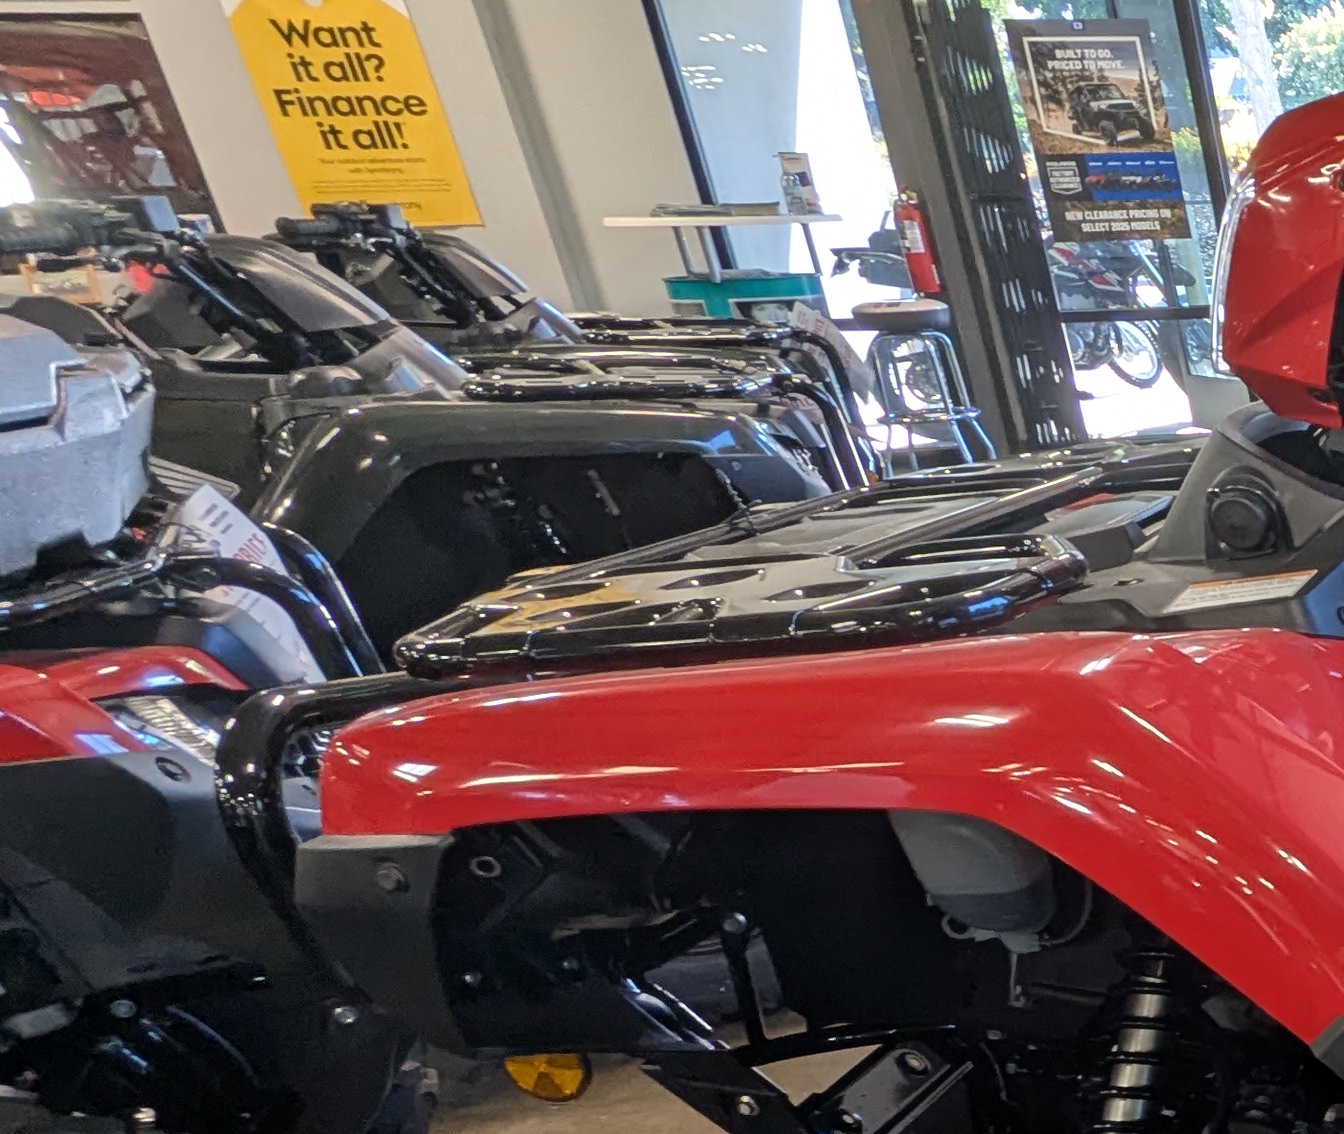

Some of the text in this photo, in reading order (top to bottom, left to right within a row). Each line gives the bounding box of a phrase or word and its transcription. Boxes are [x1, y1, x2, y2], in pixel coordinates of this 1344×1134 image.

[267, 18, 382, 48] Want
[286, 52, 385, 82] it all?
[1046, 60, 1082, 70] PRICED
[1082, 60, 1096, 70] TO
[1055, 49, 1081, 59] BUILT
[1083, 49, 1097, 59] TO
[273, 87, 428, 117] Finance
[316, 120, 409, 150] it all!
